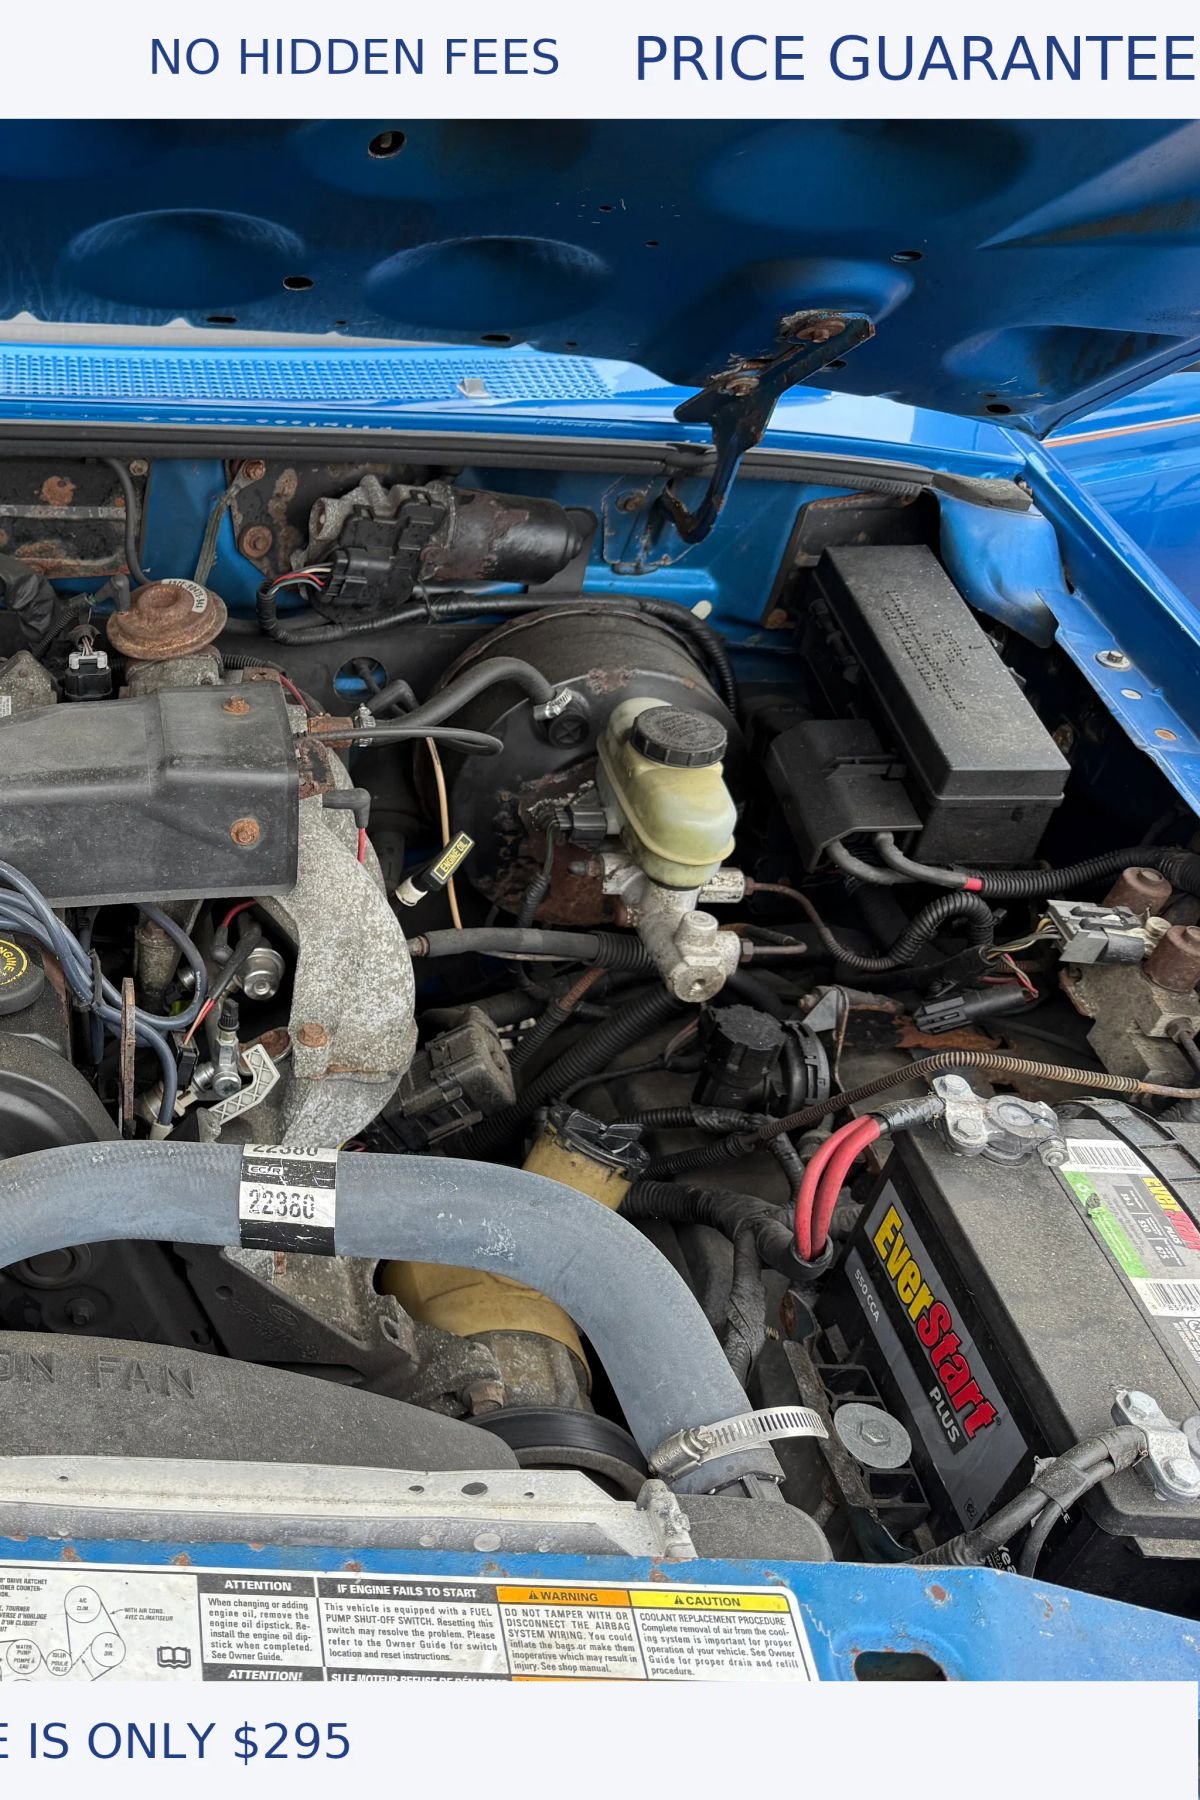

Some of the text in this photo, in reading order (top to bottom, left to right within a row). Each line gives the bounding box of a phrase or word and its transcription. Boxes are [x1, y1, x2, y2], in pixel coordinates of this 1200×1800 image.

[440, 841, 468, 872] ENGINE OIL
[249, 1189, 315, 1219] 22380
[855, 1268, 880, 1323] 550 CCA
[872, 1203, 999, 1441] EverStart
[97, 1354, 196, 1400] FAN
[929, 1385, 960, 1444] PLUS
[224, 1580, 291, 1591] ATTENTION
[337, 1584, 477, 1598] IF ENGINE FAILS TO START
[540, 1592, 598, 1601] WARNING
[686, 1596, 741, 1607] CAUTION
[208, 1598, 231, 1607] When
[233, 1599, 269, 1609] changing
[282, 1601, 308, 1611] adding
[325, 1603, 343, 1611] This
[347, 1604, 379, 1613] vehicle
[383, 1605, 391, 1613] is
[394, 1606, 435, 1615] equipped
[439, 1607, 458, 1615] with
[470, 1608, 492, 1617] FUEL
[209, 1609, 309, 1620] engine oil, remove the
[505, 1608, 628, 1620] DO NOT TAMPER WITH OR
[640, 1613, 786, 1626] COOLANT REPLACEMENT PROCEDURE
[326, 1614, 493, 1628] PUMP SHUT-OFF SWITCH. Resetting this
[507, 1619, 630, 1631] DISCONNECT THE AIRBAG
[508, 1629, 632, 1641] SYSTEM WIRING. You could
[642, 1623, 678, 1632] Complete
[680, 1626, 711, 1634] removal
[713, 1626, 720, 1634] of
[735, 1626, 752, 1635] from
[754, 1627, 767, 1635] the
[768, 1628, 789, 1636] cool-
[212, 1651, 283, 1661] See Owner Guide.
[330, 1649, 362, 1658] location
[381, 1651, 401, 1659] reset
[403, 1652, 452, 1661] instructions.
[228, 1670, 303, 1681] ATTENTION!
[651, 1667, 695, 1676] procedure.
